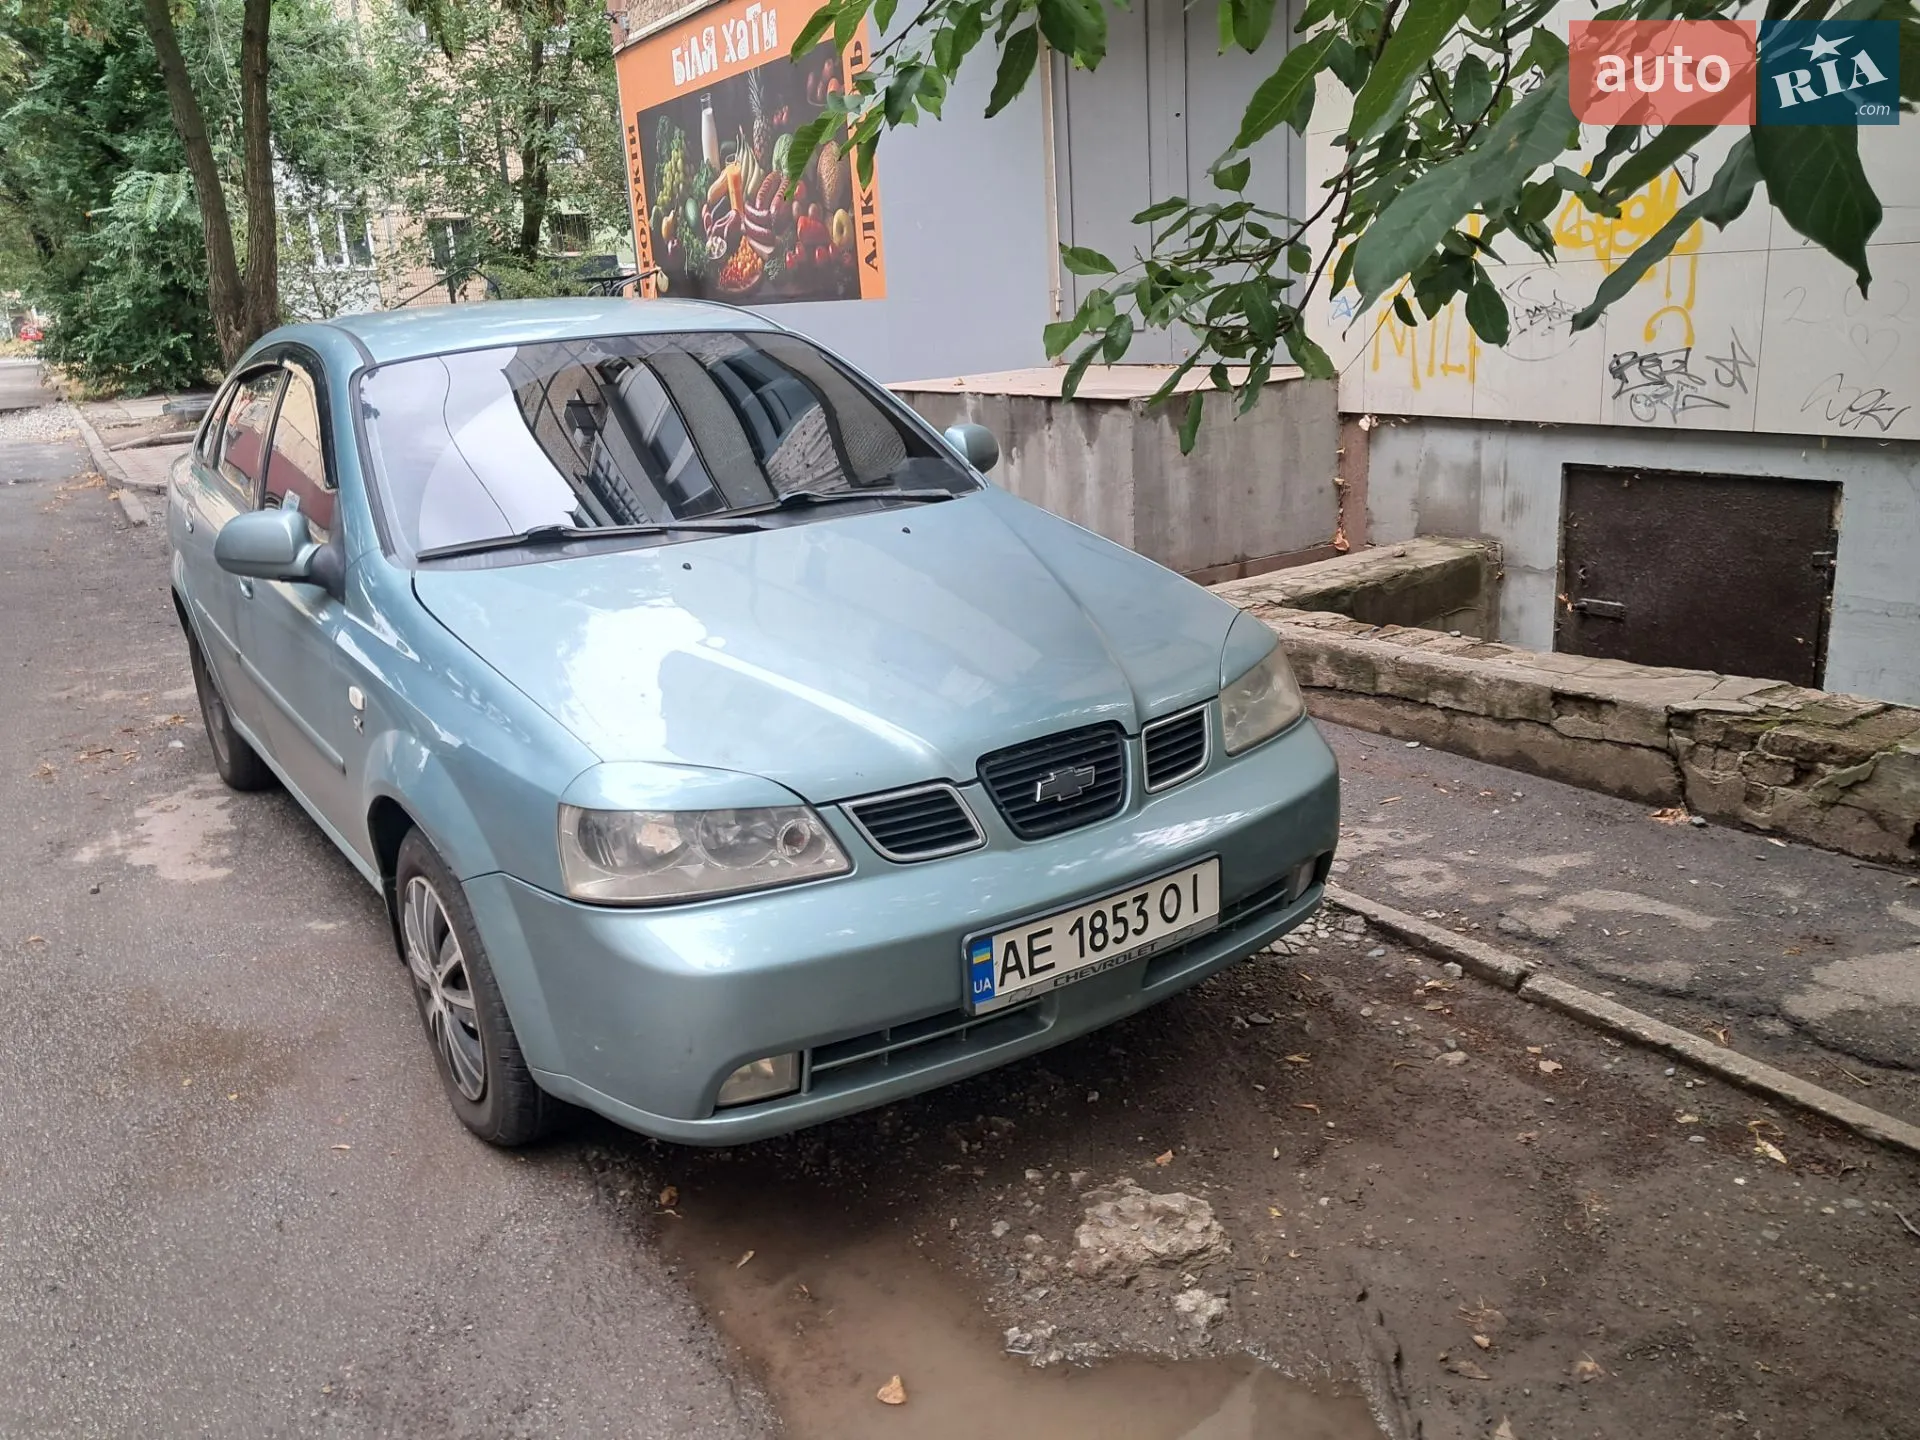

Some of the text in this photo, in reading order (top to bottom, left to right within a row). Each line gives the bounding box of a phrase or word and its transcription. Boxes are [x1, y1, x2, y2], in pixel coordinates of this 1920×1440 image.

[998, 927, 1056, 988] AE
[1068, 891, 1150, 960] 1853
[973, 978, 993, 994] UA
[1053, 943, 1159, 989] CHEVROLET
